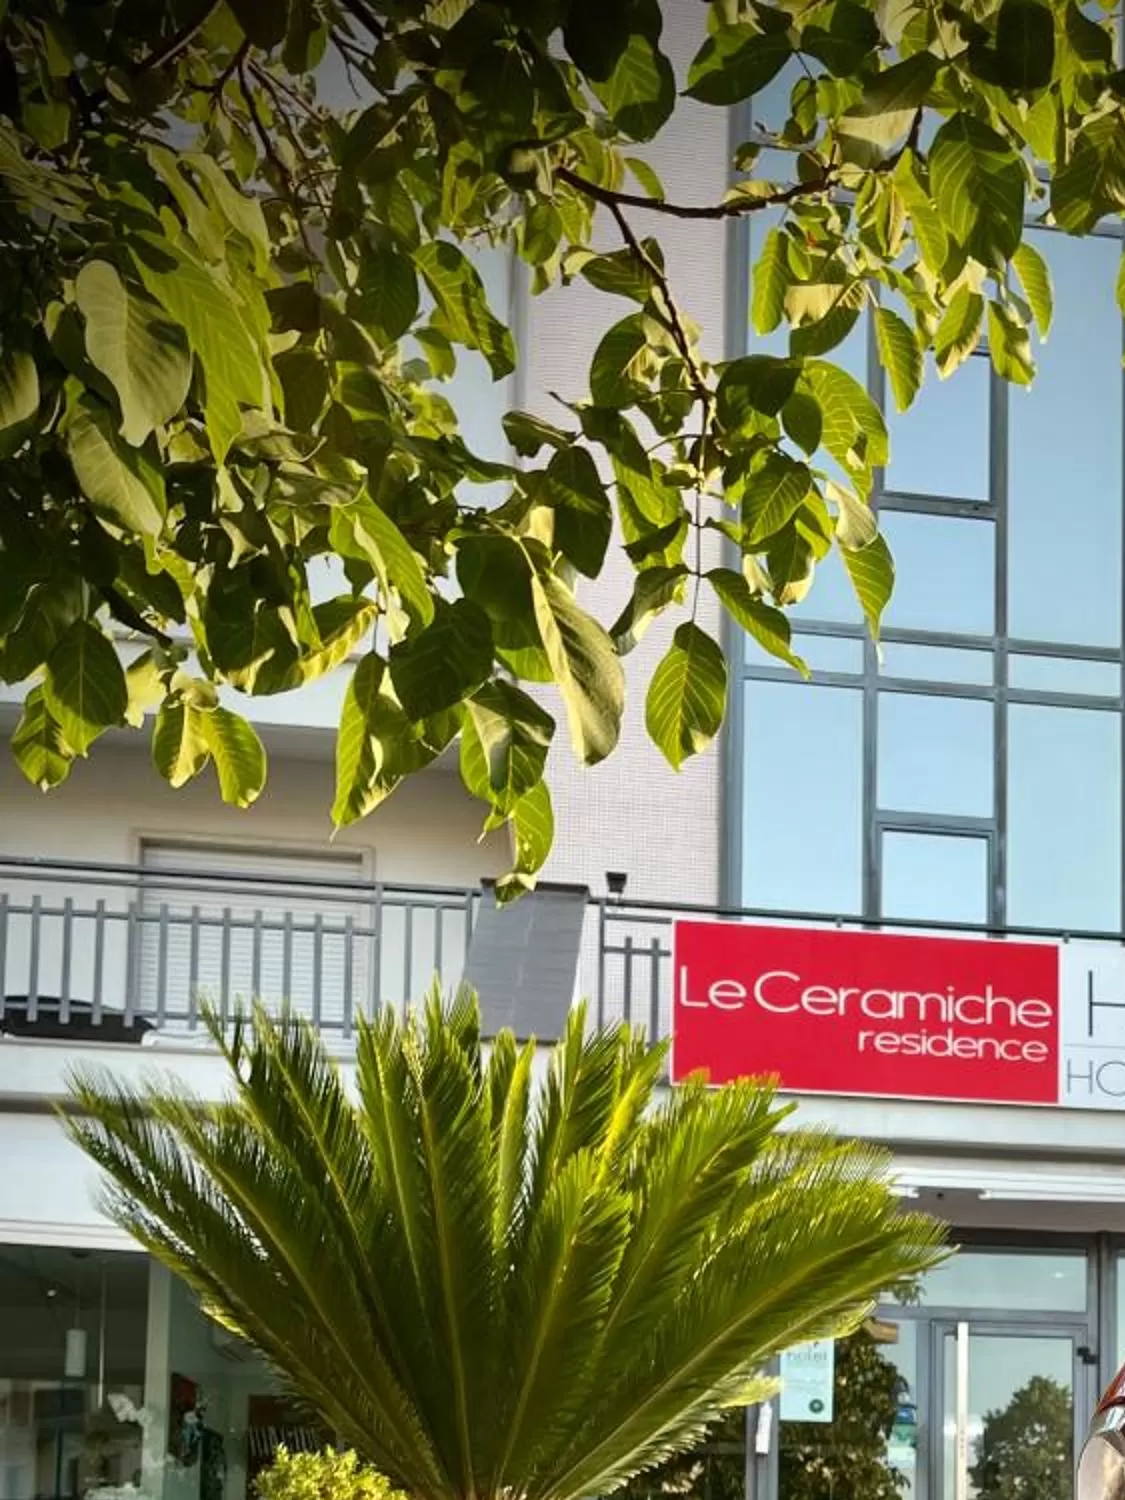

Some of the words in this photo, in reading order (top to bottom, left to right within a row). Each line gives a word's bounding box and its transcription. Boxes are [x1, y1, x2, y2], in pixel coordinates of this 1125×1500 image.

[680, 966, 745, 1008] Le
[754, 971, 1053, 1028] Ceramiche
[858, 1029, 1048, 1062] residence
